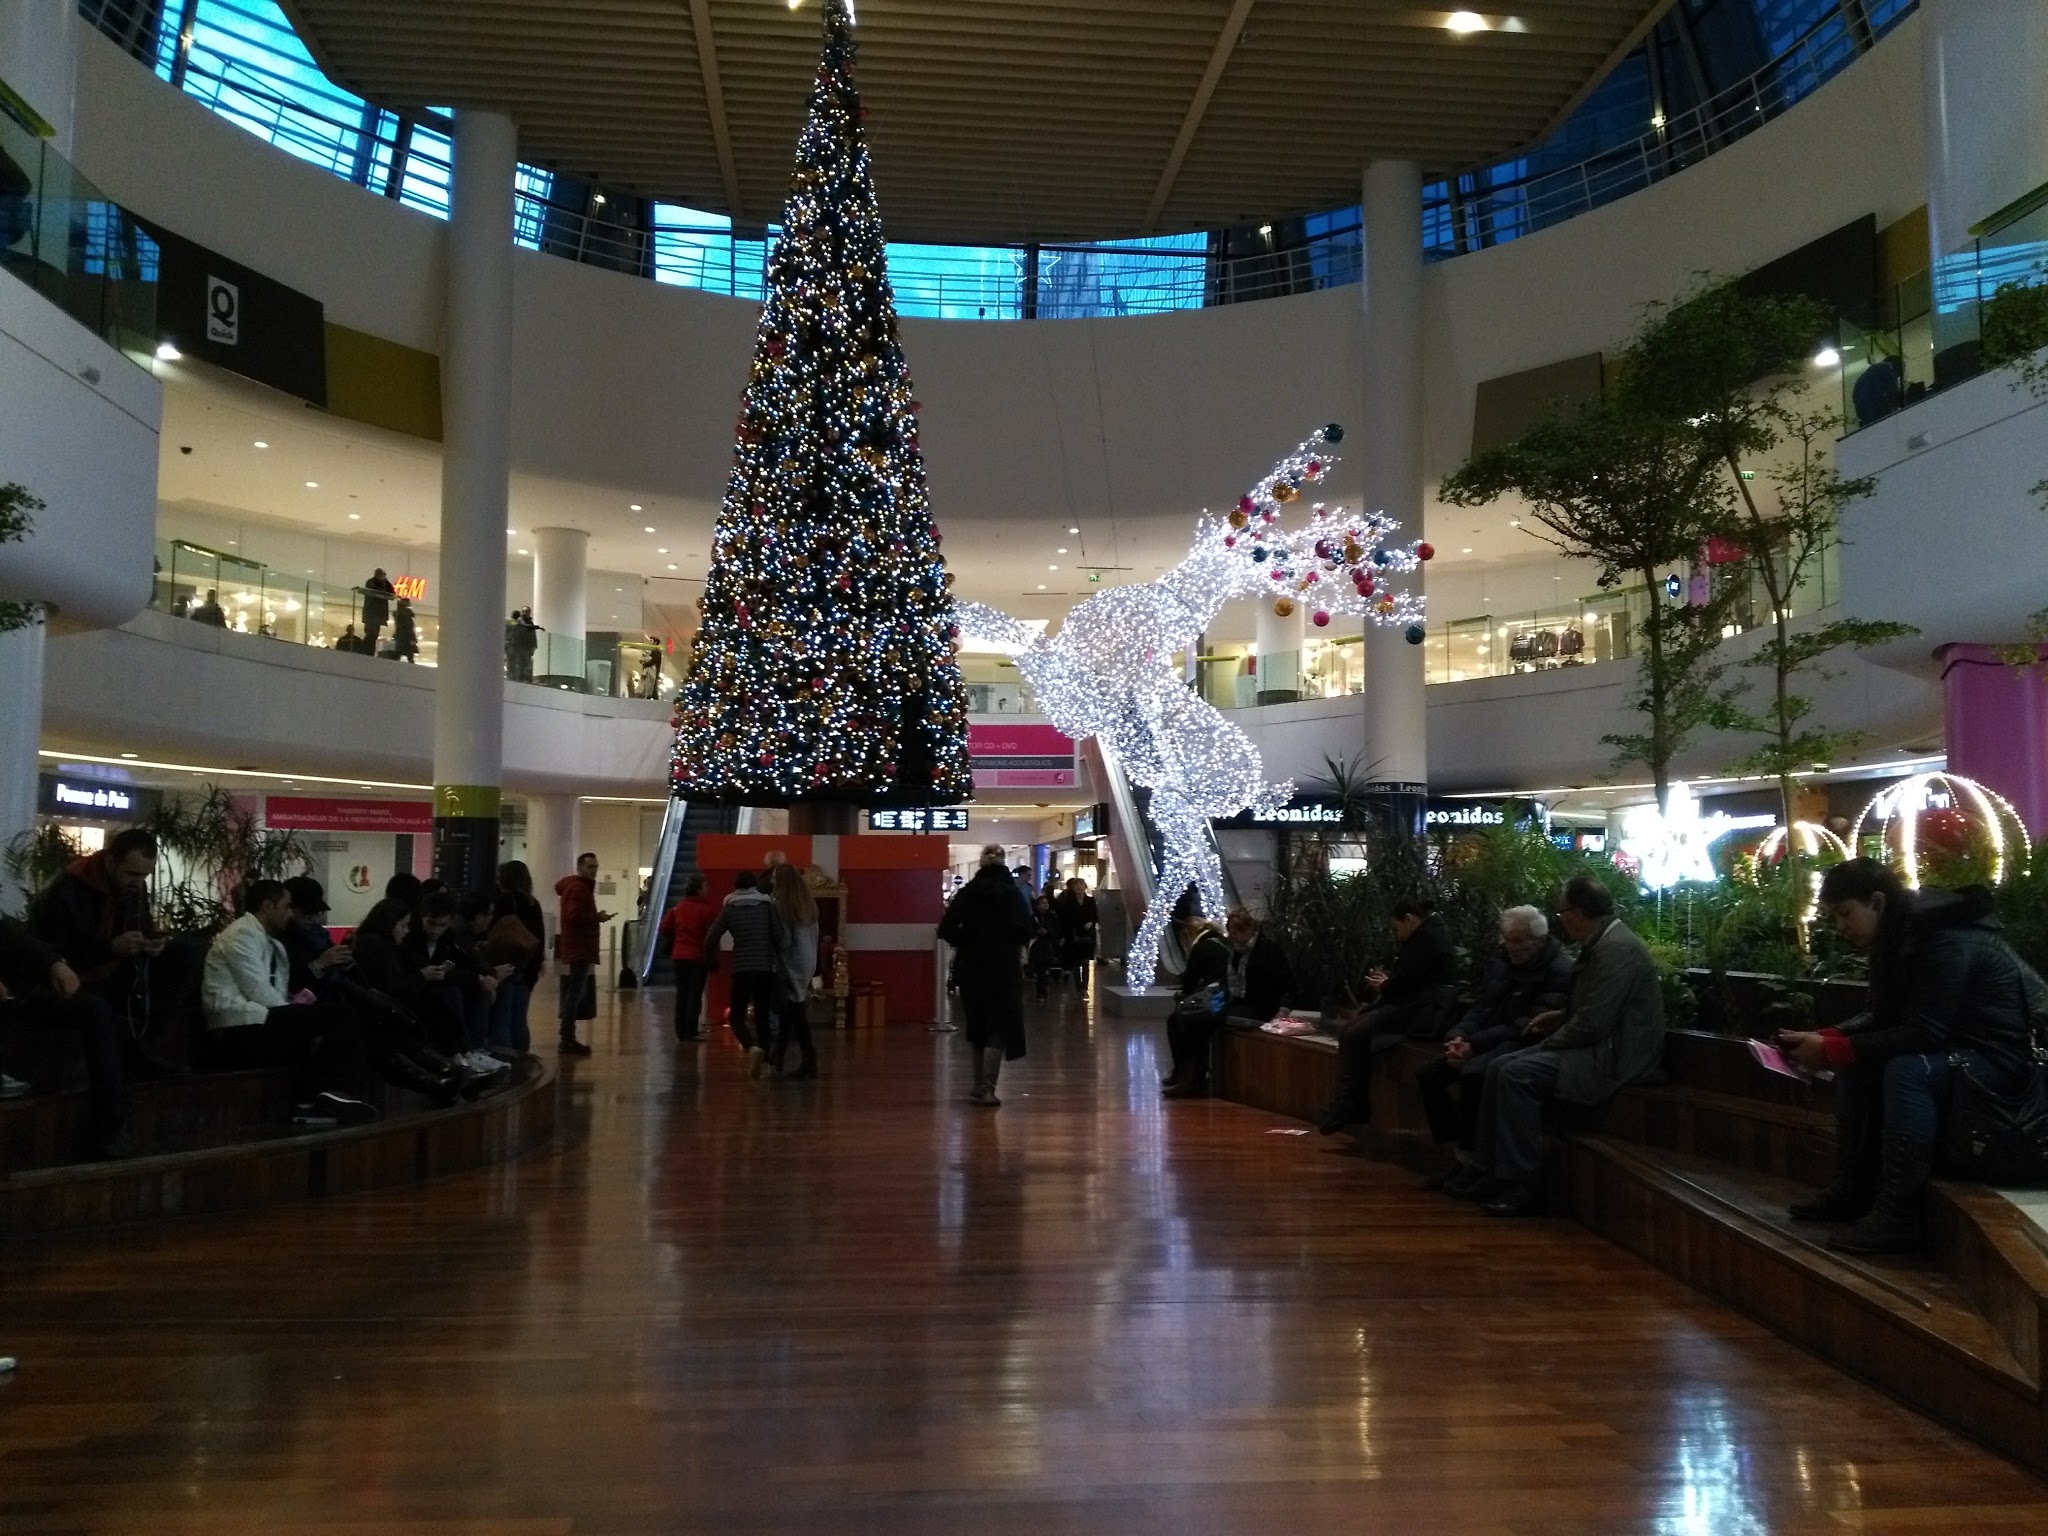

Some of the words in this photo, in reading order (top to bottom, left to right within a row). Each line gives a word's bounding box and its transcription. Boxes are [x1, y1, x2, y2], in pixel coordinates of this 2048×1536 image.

[211, 285, 235, 328] Q
[210, 327, 235, 340] Quick
[393, 576, 426, 600] H&M
[1001, 742, 1018, 750] DVD
[1253, 803, 1344, 822] Leonidas
[1426, 806, 1504, 824] eonidas
